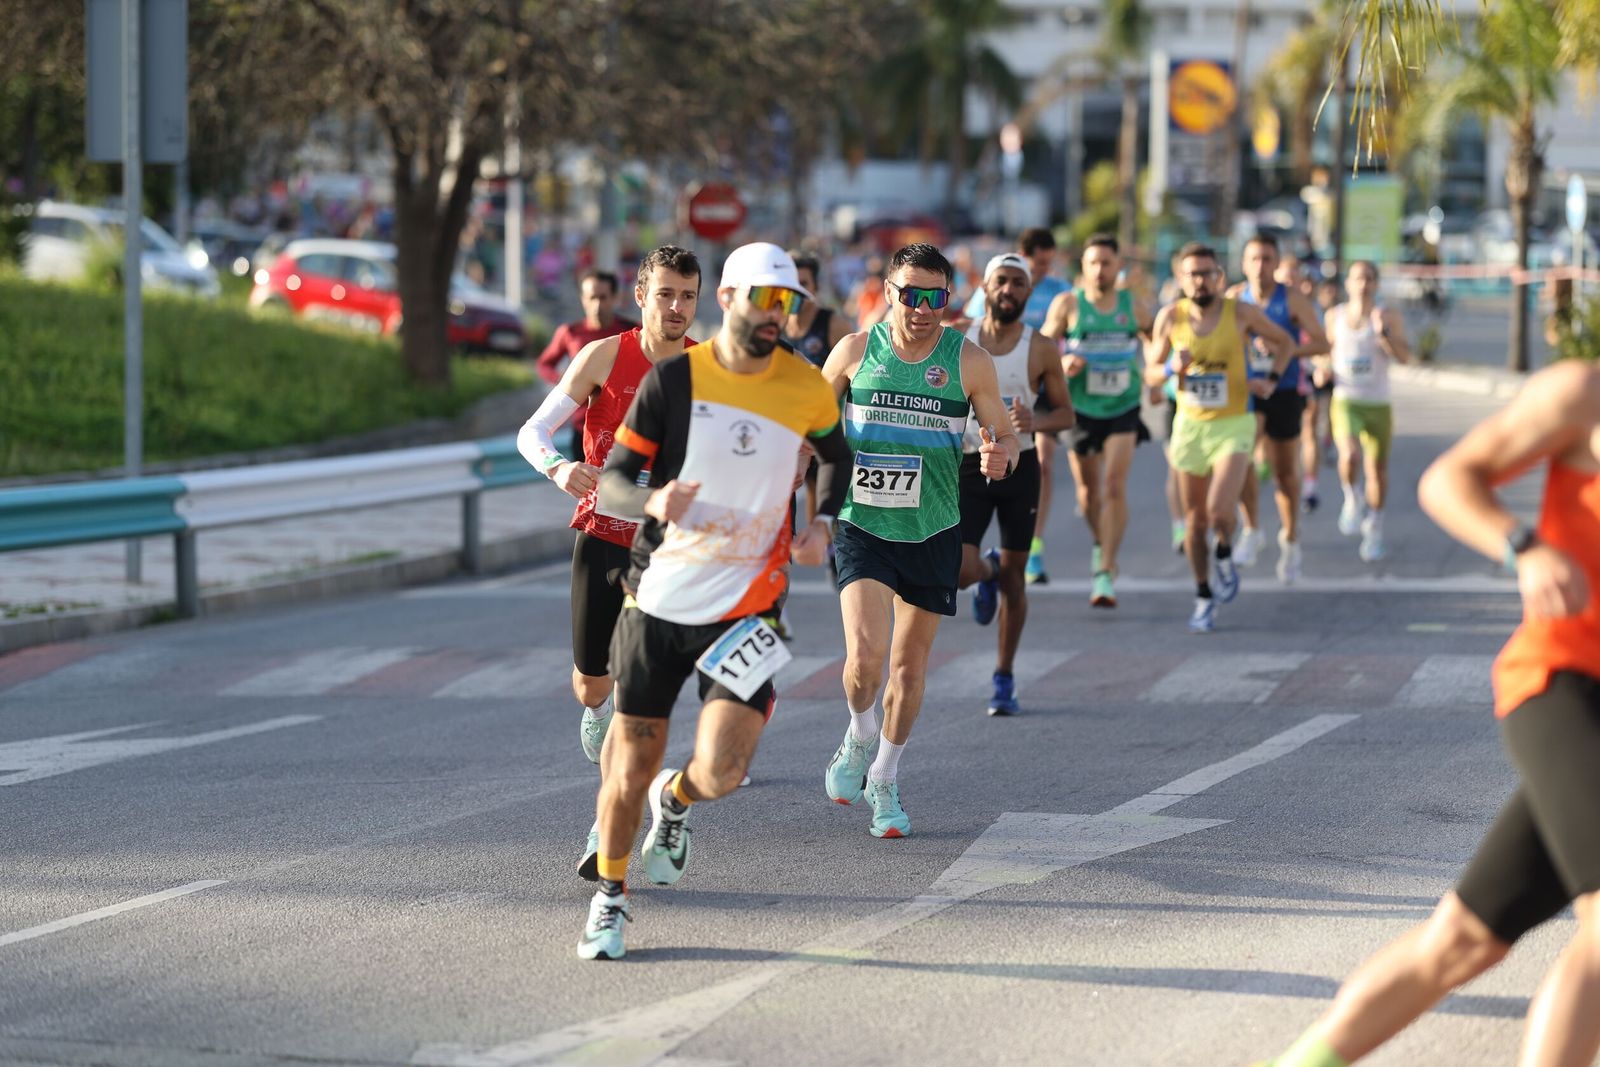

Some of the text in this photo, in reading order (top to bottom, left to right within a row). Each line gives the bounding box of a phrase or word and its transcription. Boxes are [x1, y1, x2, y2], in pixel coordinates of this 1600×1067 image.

[871, 392, 942, 412] ATLETISMO
[856, 467, 918, 491] 2377
[719, 628, 776, 679] 1775
